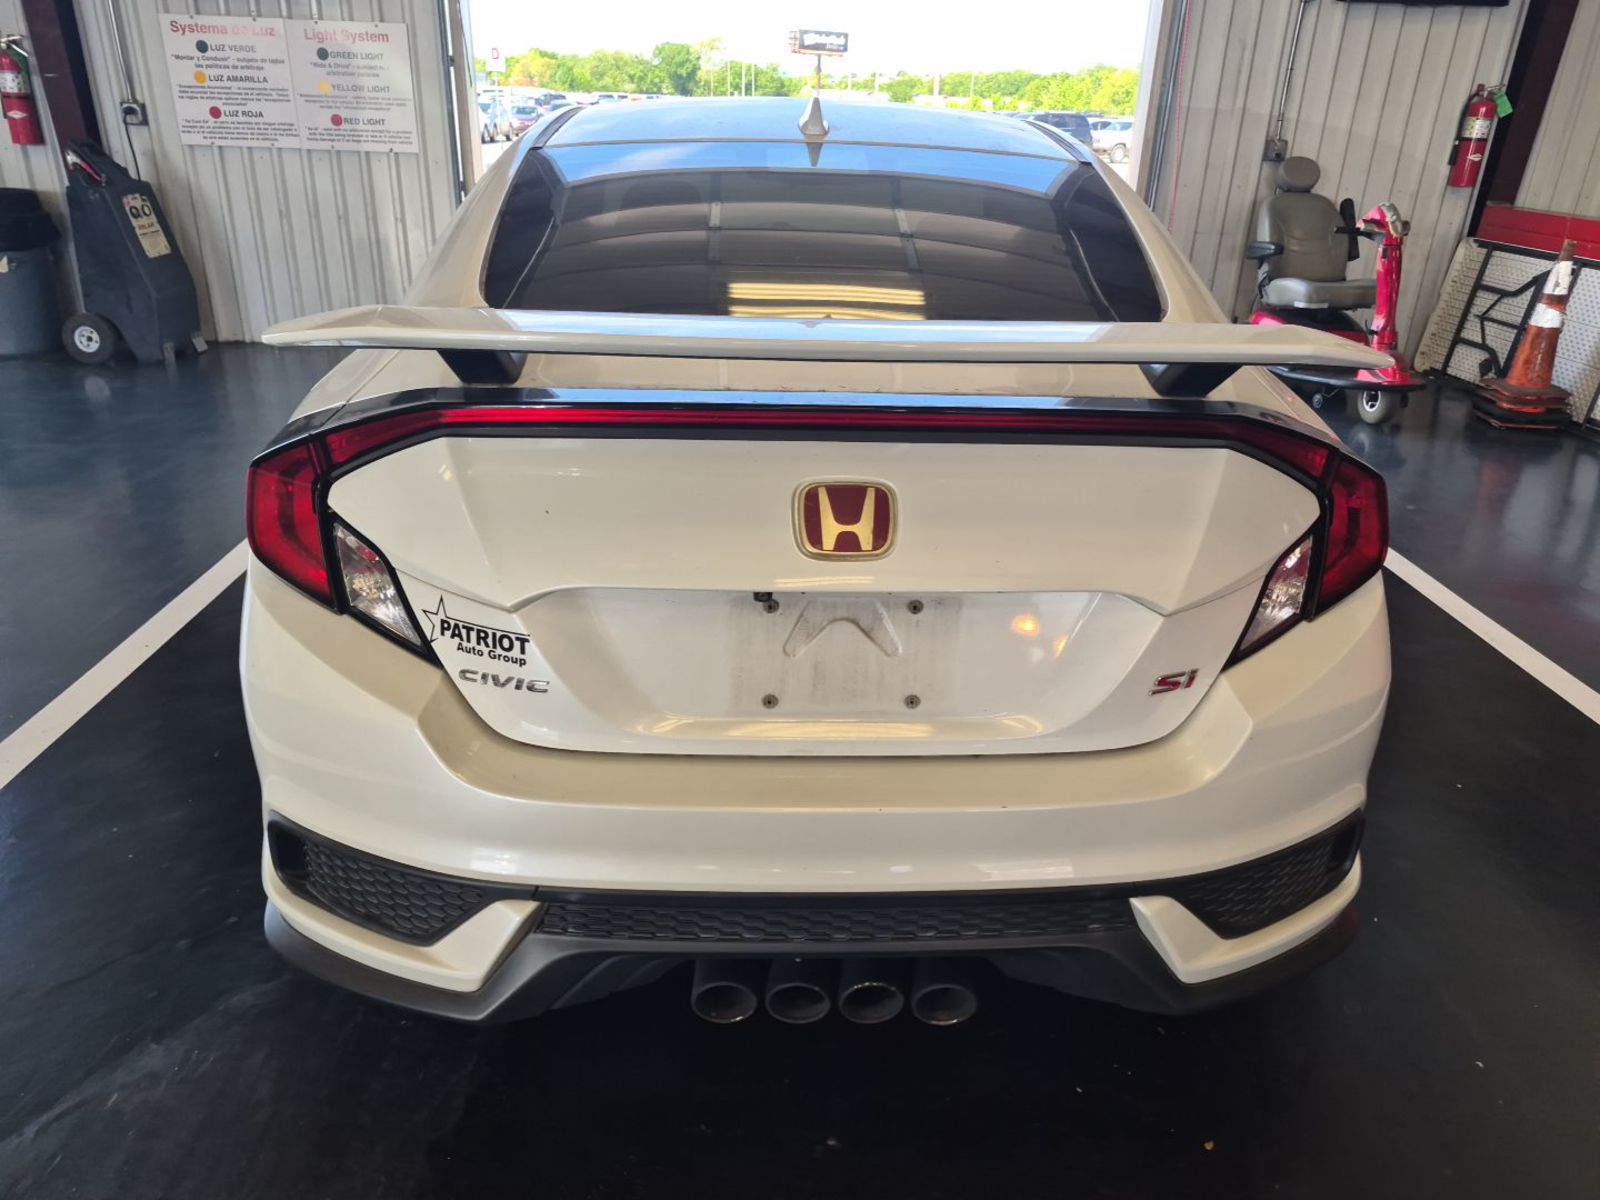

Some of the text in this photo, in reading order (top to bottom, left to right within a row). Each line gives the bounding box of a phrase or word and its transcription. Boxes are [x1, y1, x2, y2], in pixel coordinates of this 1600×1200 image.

[170, 20, 228, 36] Systema
[304, 28, 389, 44] Light System
[209, 44, 256, 53] LUZ VERDE
[330, 51, 384, 61] GREEN LIGHT
[208, 74, 269, 83] LUZ AMARILLA
[332, 84, 390, 93] YELLOW LIGHT
[224, 109, 264, 118] LUZ ROJA
[344, 117, 386, 126] RED LIGHT
[440, 618, 530, 655] PATRIOT
[457, 642, 527, 667] Auto Group
[458, 668, 550, 693] CIVIC
